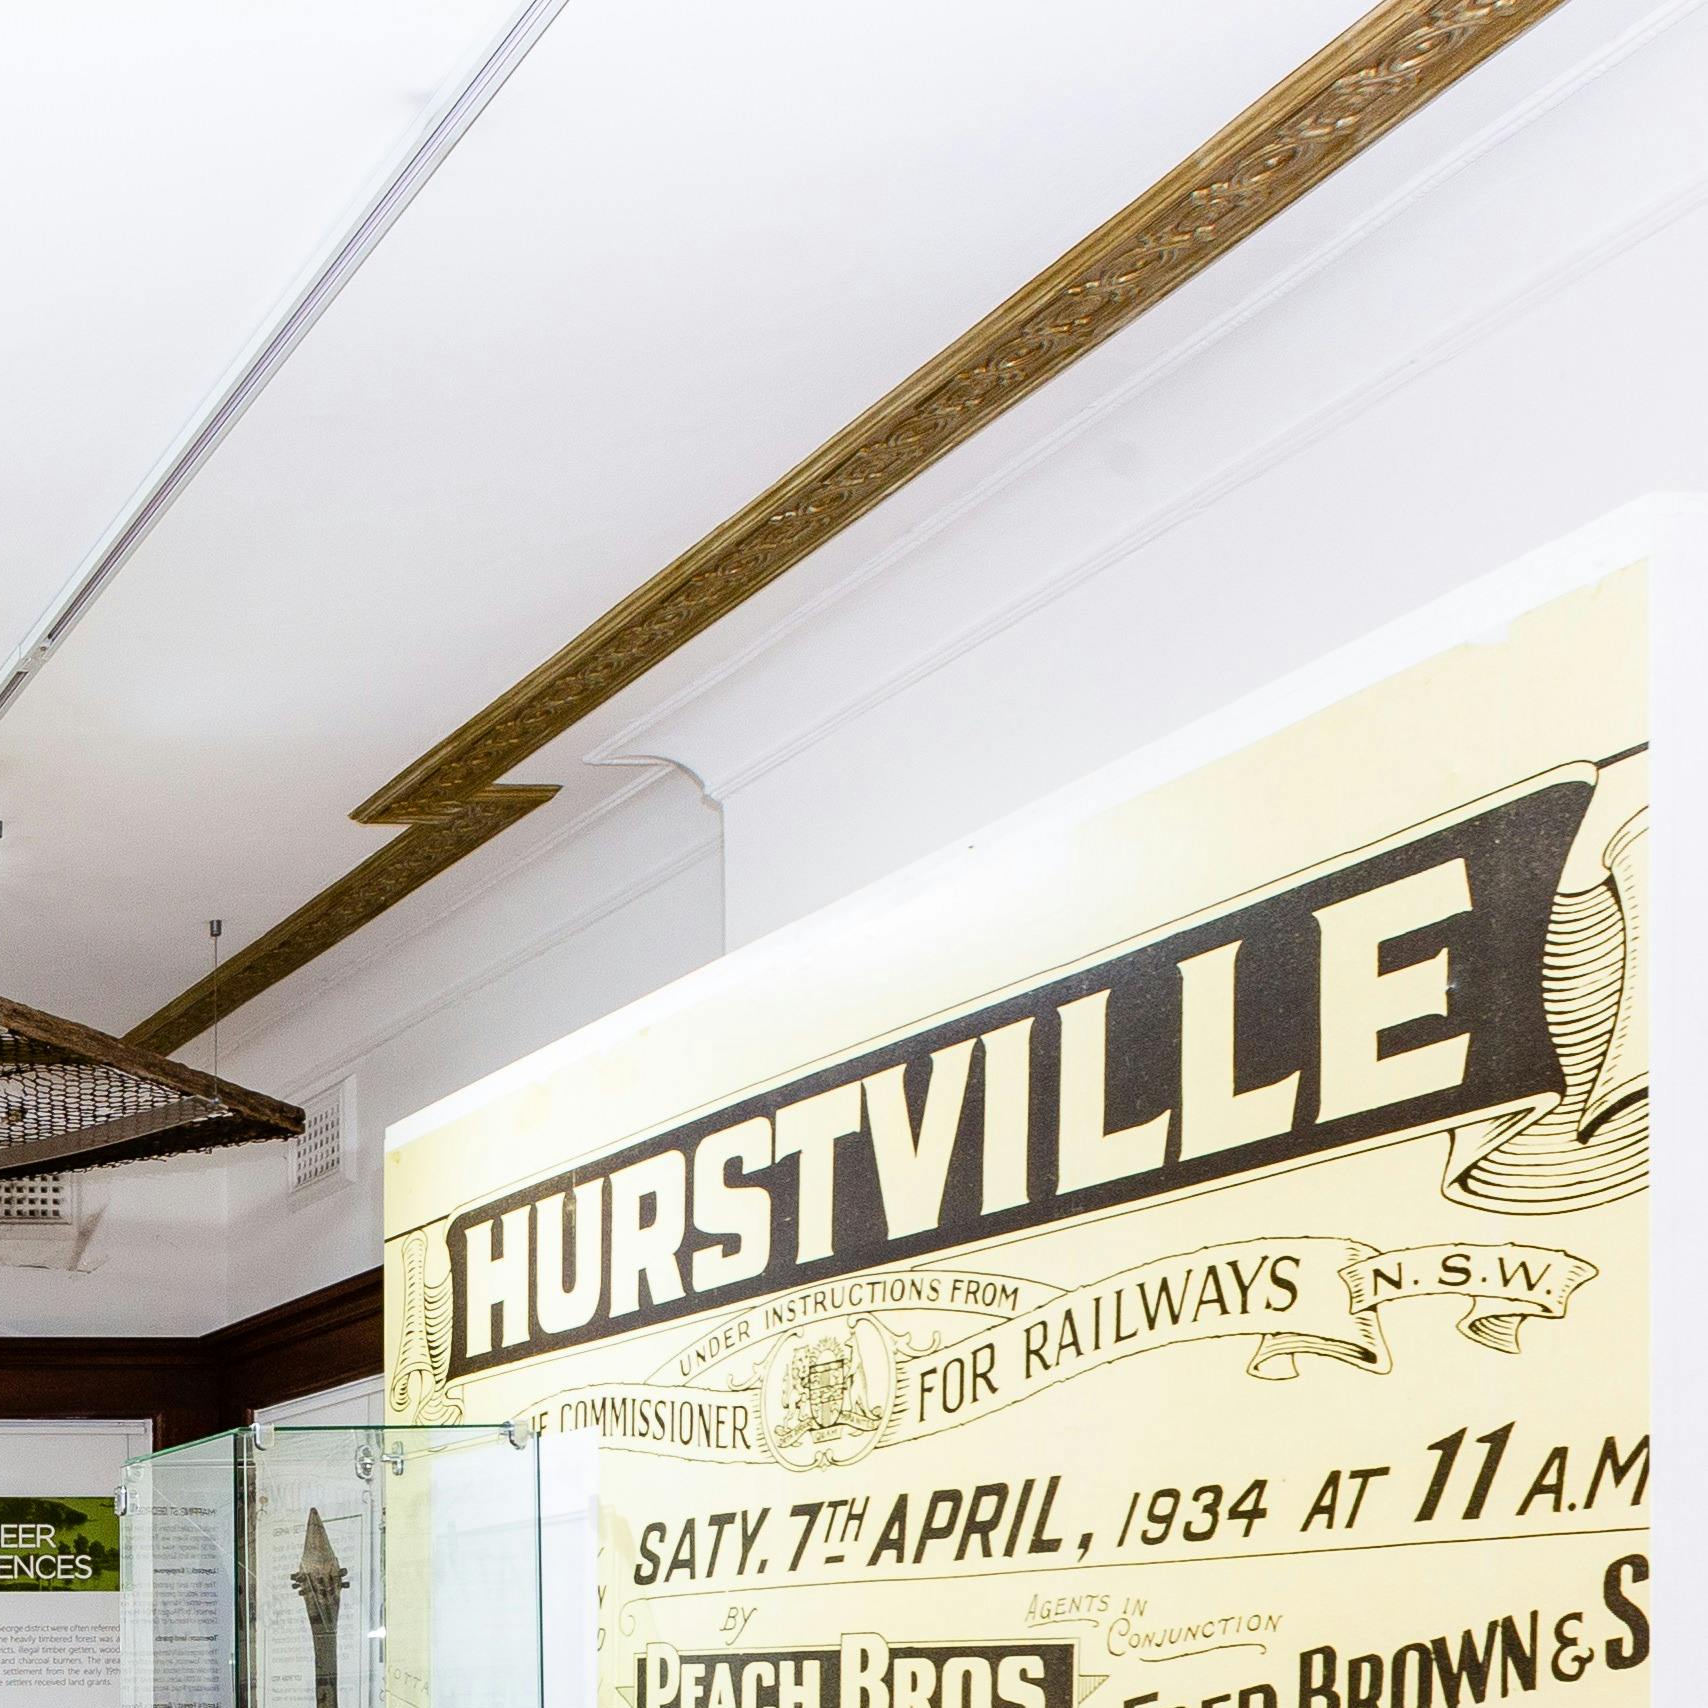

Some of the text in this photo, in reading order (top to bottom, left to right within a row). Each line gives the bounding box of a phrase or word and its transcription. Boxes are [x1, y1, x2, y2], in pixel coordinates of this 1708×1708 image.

[466, 857, 1474, 1359] HURSTVILLE
[680, 1278, 1019, 1377] UNDER INSTRUCTIONS FROM
[919, 1342, 996, 1422] FOR
[1024, 1255, 1301, 1380] RAILWAYS
[632, 1507, 771, 1586] SATY.
[867, 1475, 1094, 1568] APRIL,
[1116, 1478, 1269, 1547] 1934
[1299, 1466, 1391, 1532] AT
[1414, 1420, 1516, 1522] 11
[719, 1606, 759, 1647] BY
[1025, 1593, 1148, 1624] AGENTS IN
[1106, 1613, 1285, 1656] CONJUNCTION
[1550, 1610, 1595, 1683] &
